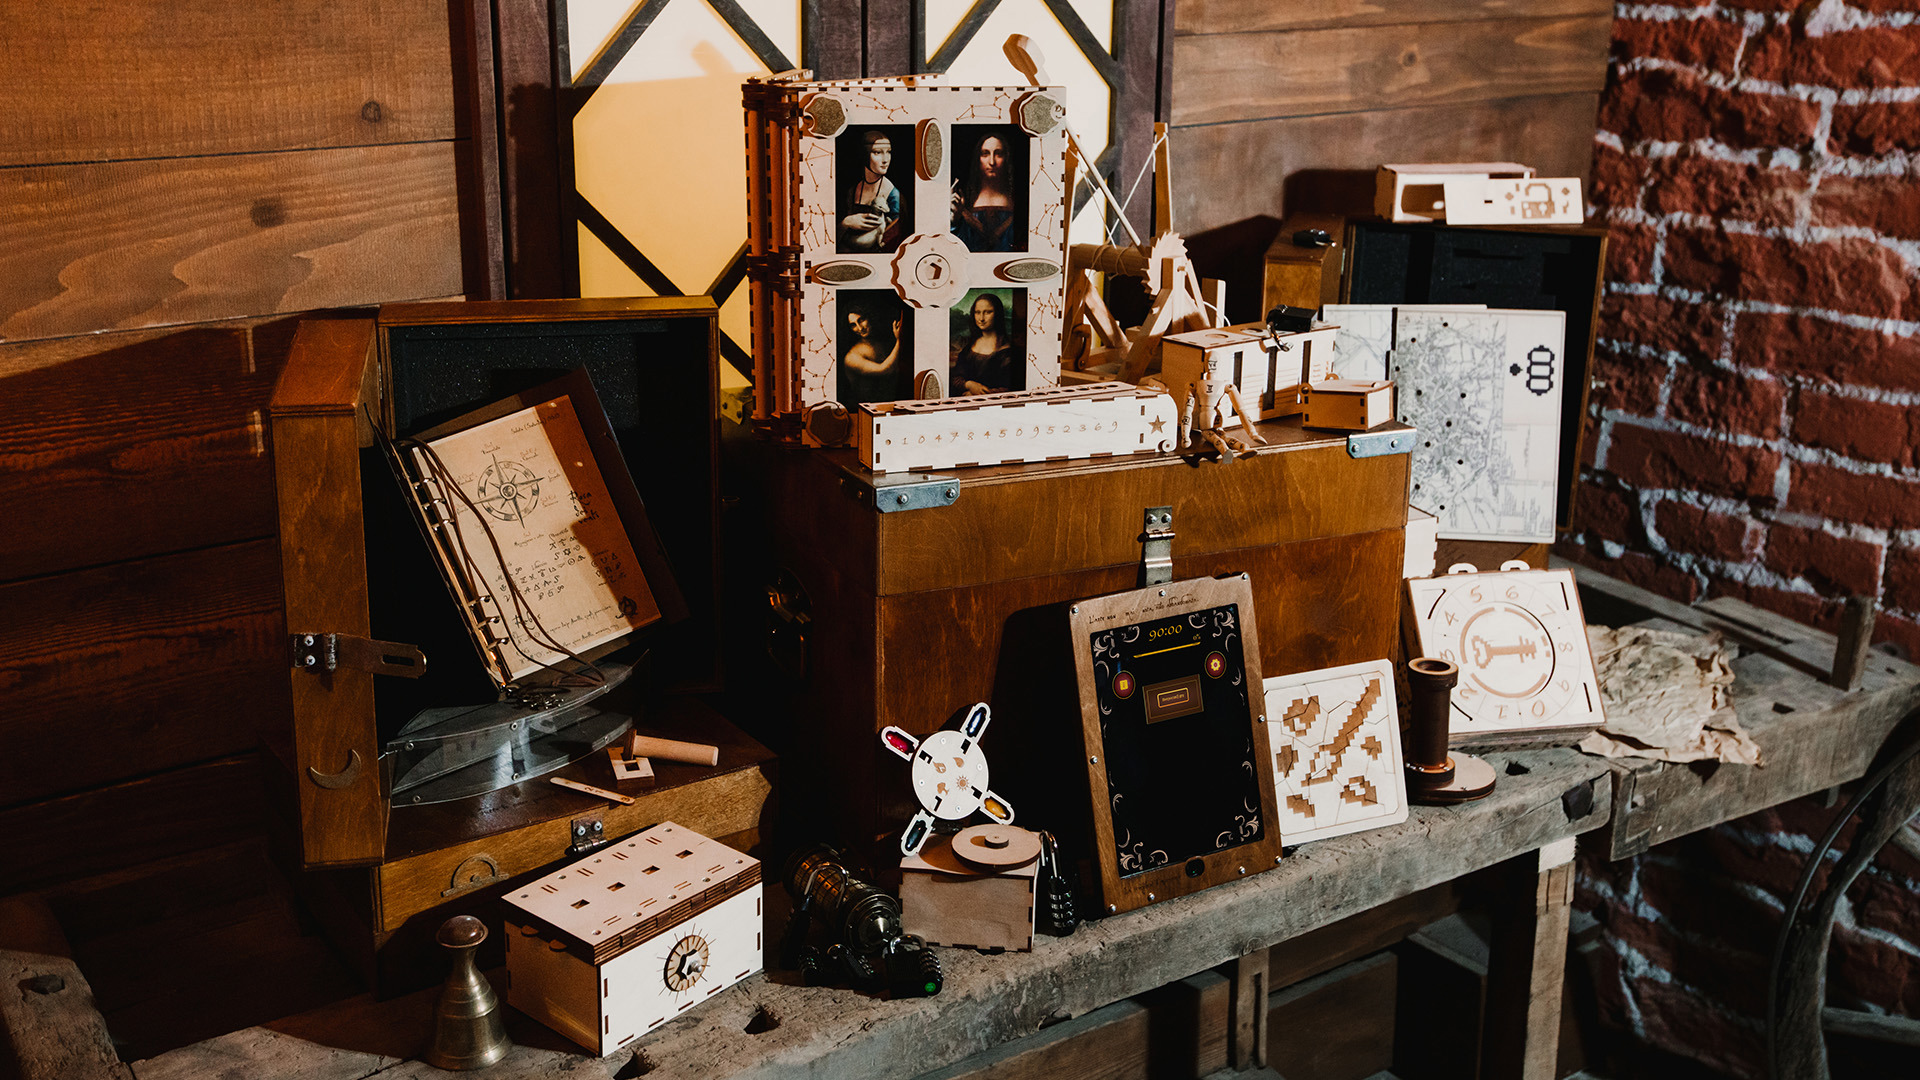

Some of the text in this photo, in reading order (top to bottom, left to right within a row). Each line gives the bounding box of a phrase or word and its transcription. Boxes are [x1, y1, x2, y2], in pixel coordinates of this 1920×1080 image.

[1470, 585, 1482, 603] 5
[1505, 585, 1519, 600] 6
[1444, 610, 1459, 626] 4
[1541, 603, 1556, 617] 7
[1149, 624, 1182, 642] 90:00
[1558, 641, 1573, 653] 8
[1460, 682, 1478, 699] 2
[1494, 705, 1508, 719] 1
[1531, 700, 1545, 718] 0
